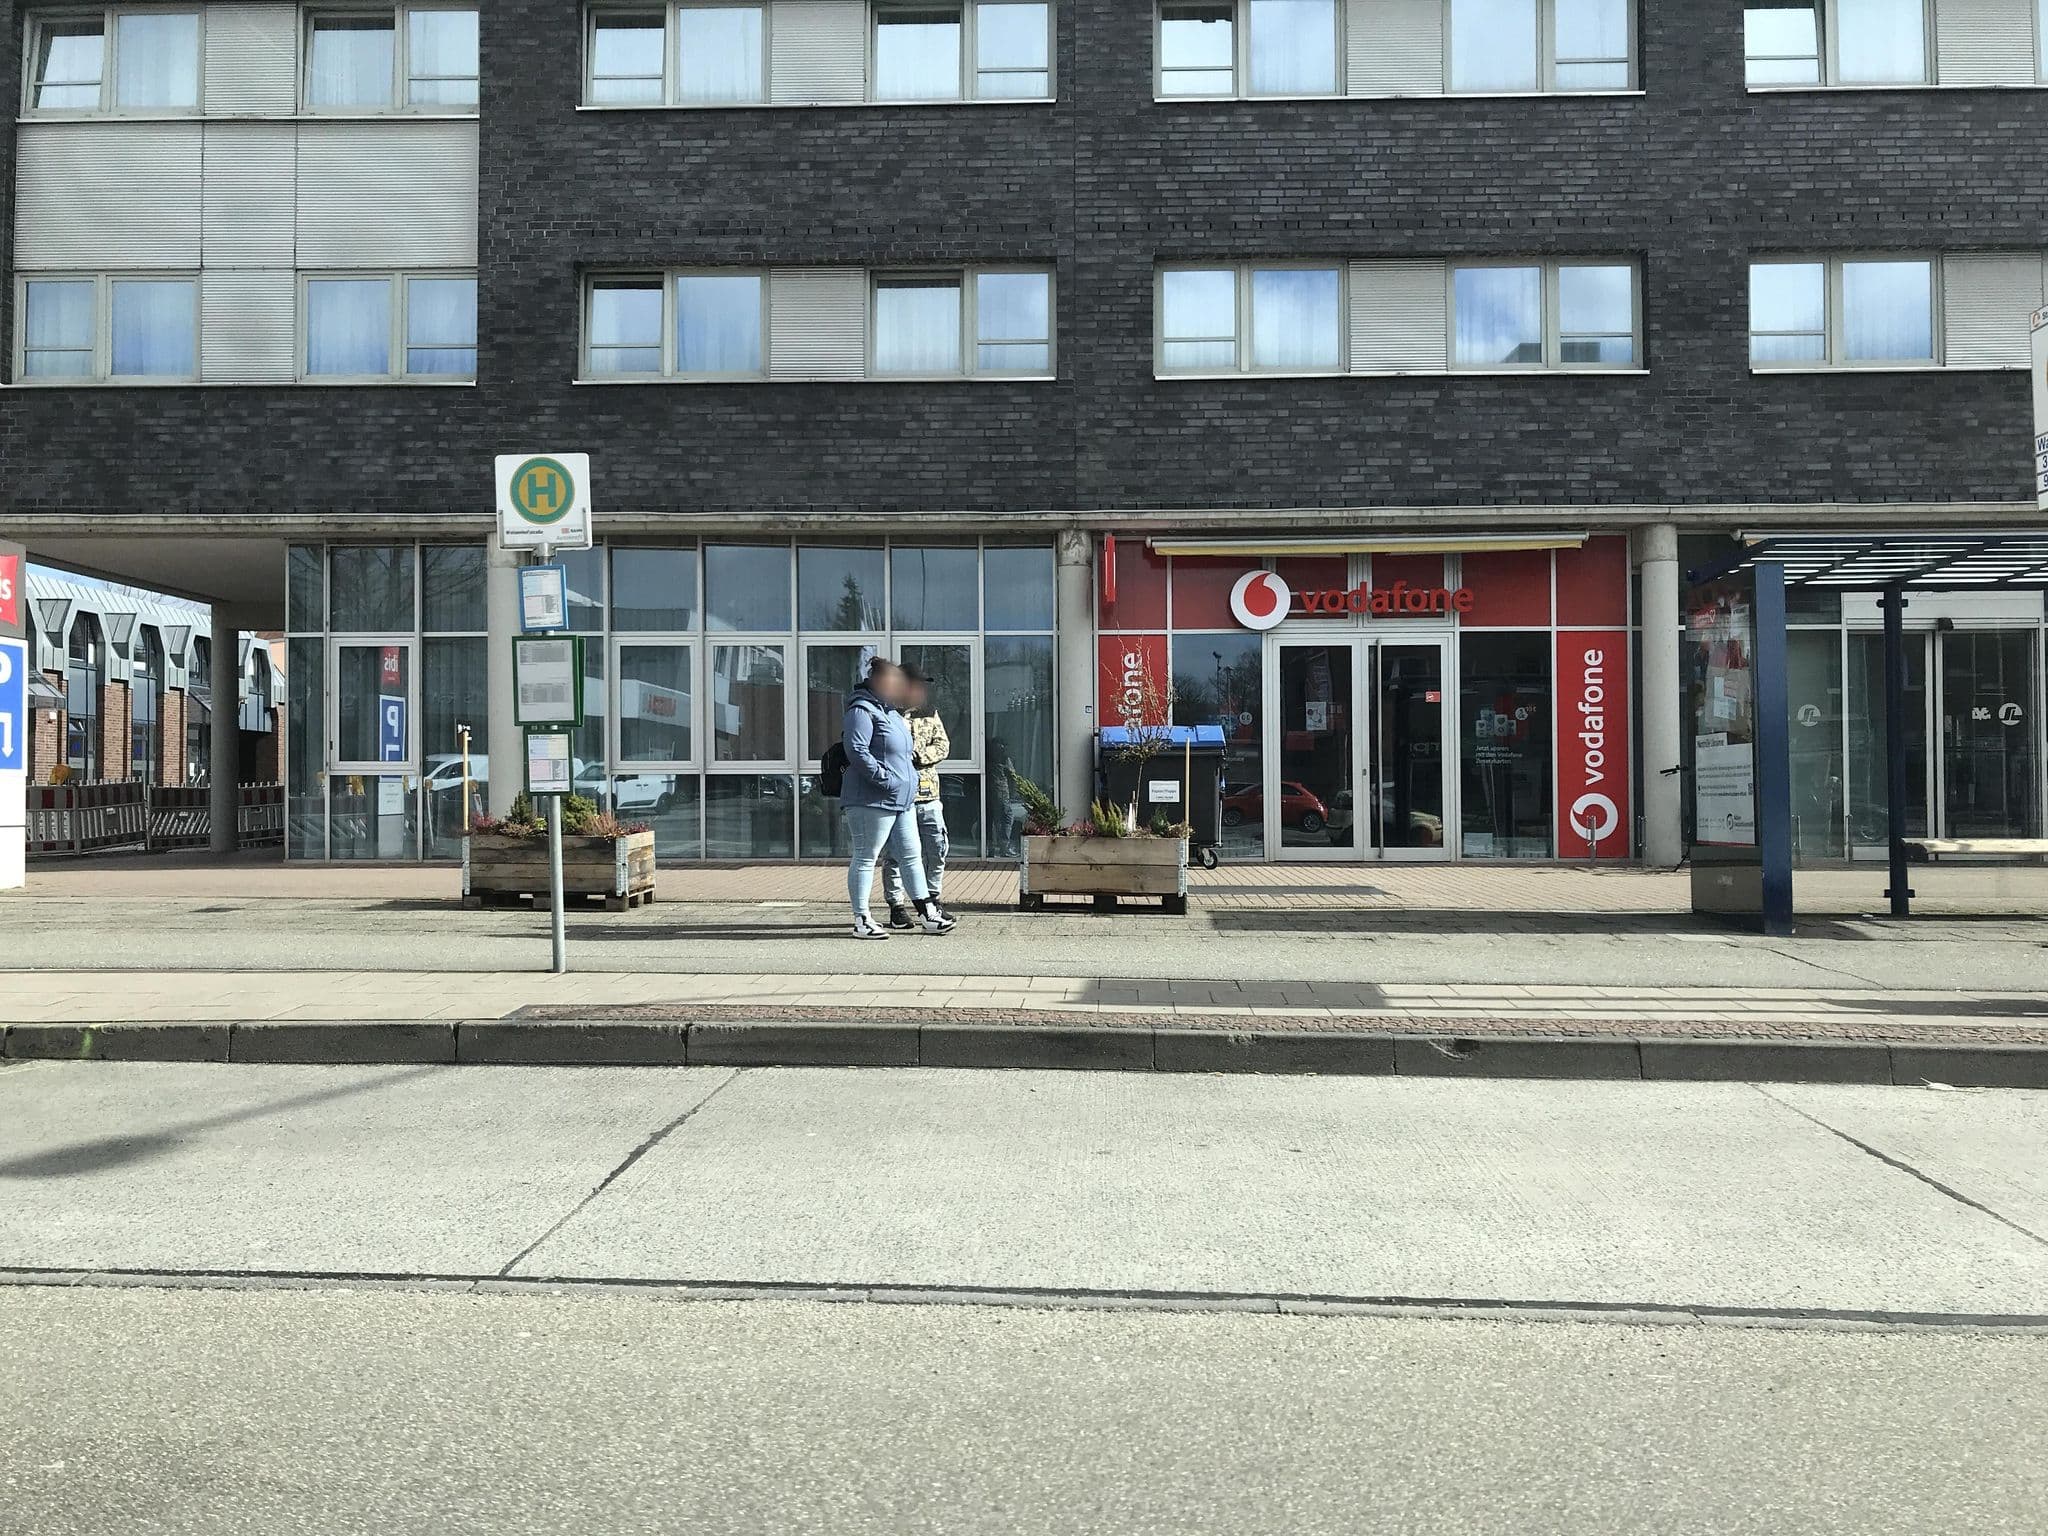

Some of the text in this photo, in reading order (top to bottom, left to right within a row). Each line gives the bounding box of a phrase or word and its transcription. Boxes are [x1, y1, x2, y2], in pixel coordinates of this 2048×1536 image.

[528, 473, 557, 508] H
[1300, 580, 1475, 614] vodafone
[1578, 649, 1604, 786] vodafone
